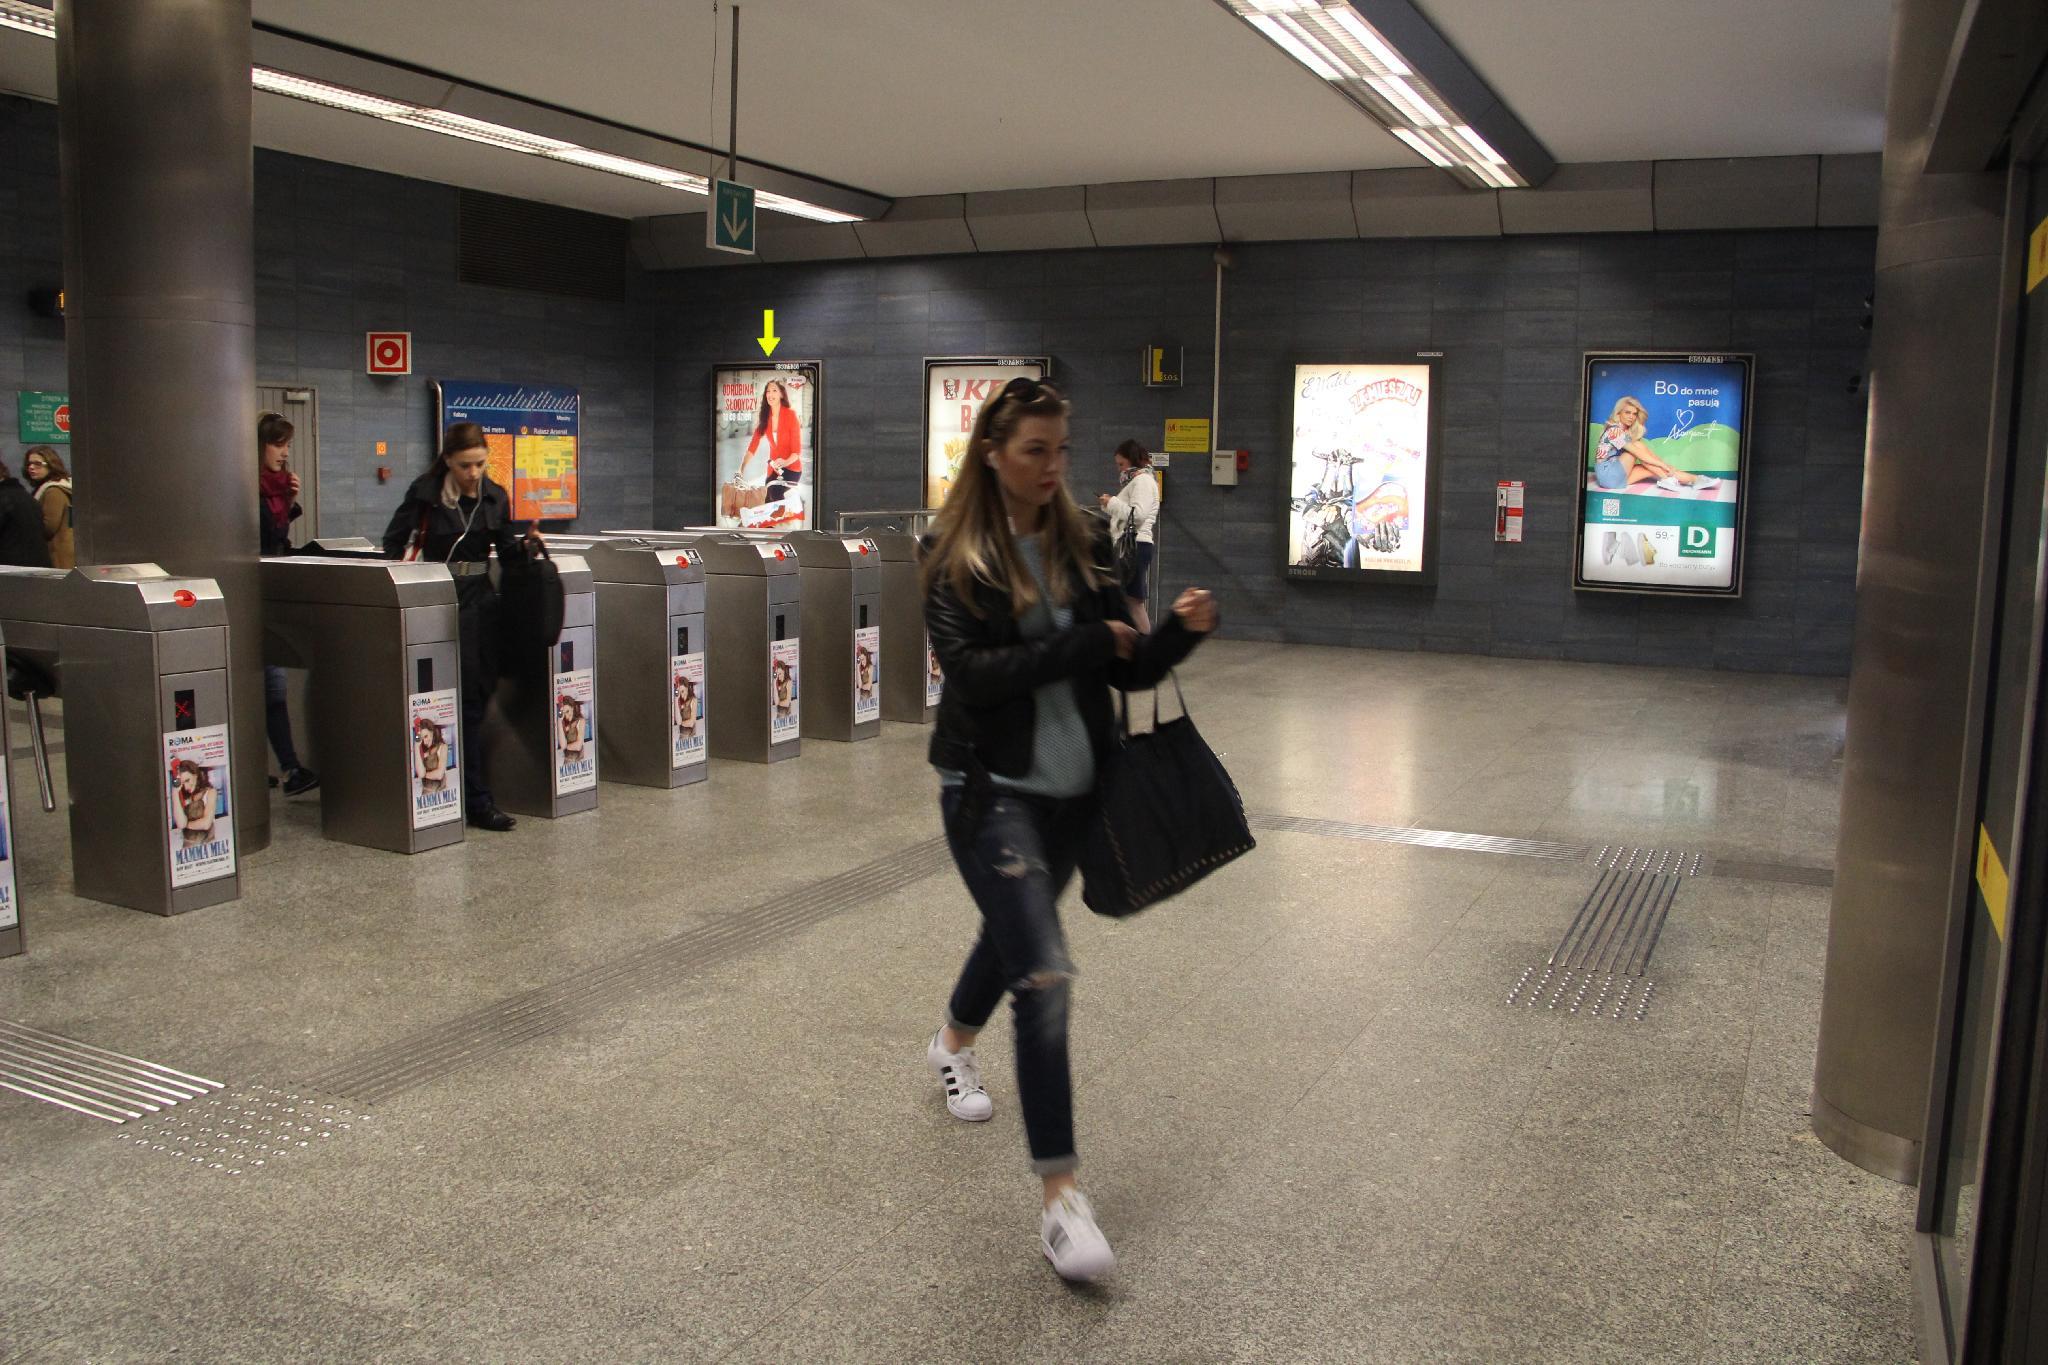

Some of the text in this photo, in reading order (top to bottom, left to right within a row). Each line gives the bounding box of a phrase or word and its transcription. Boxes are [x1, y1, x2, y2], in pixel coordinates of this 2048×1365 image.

[722, 384, 754, 396] ODROBINA
[1654, 381, 1719, 396] Bo do mnie
[412, 698, 431, 706] ROMA
[169, 736, 193, 746] ROMA
[416, 791, 442, 809] MAMMA
[175, 843, 209, 865] MAMMA
[210, 839, 229, 857] MIA!
